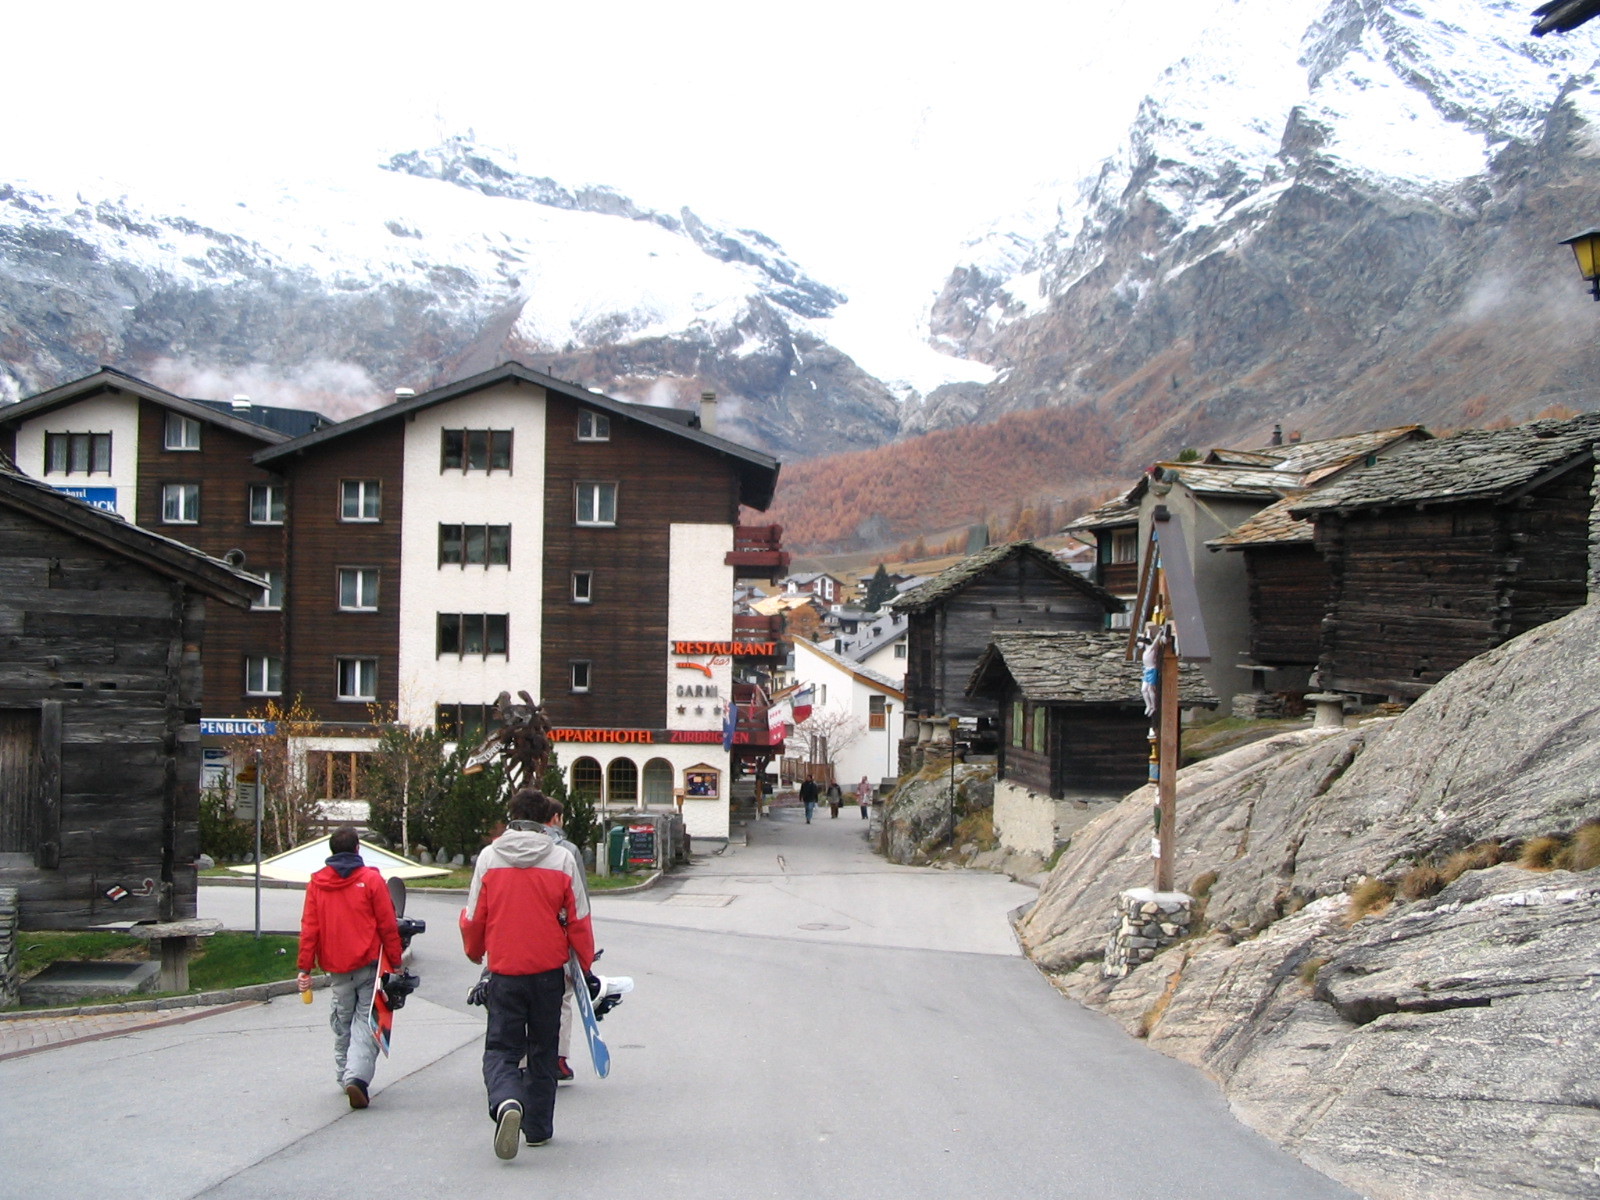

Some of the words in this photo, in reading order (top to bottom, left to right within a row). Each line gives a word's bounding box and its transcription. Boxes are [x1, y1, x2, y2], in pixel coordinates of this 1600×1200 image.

[675, 641, 776, 656] RESTAURANT
[676, 684, 718, 698] GARNI
[200, 722, 267, 735] PENBLICK
[546, 729, 654, 744] APPARTHOTEL
[670, 730, 750, 744] ZURBRIGEN
